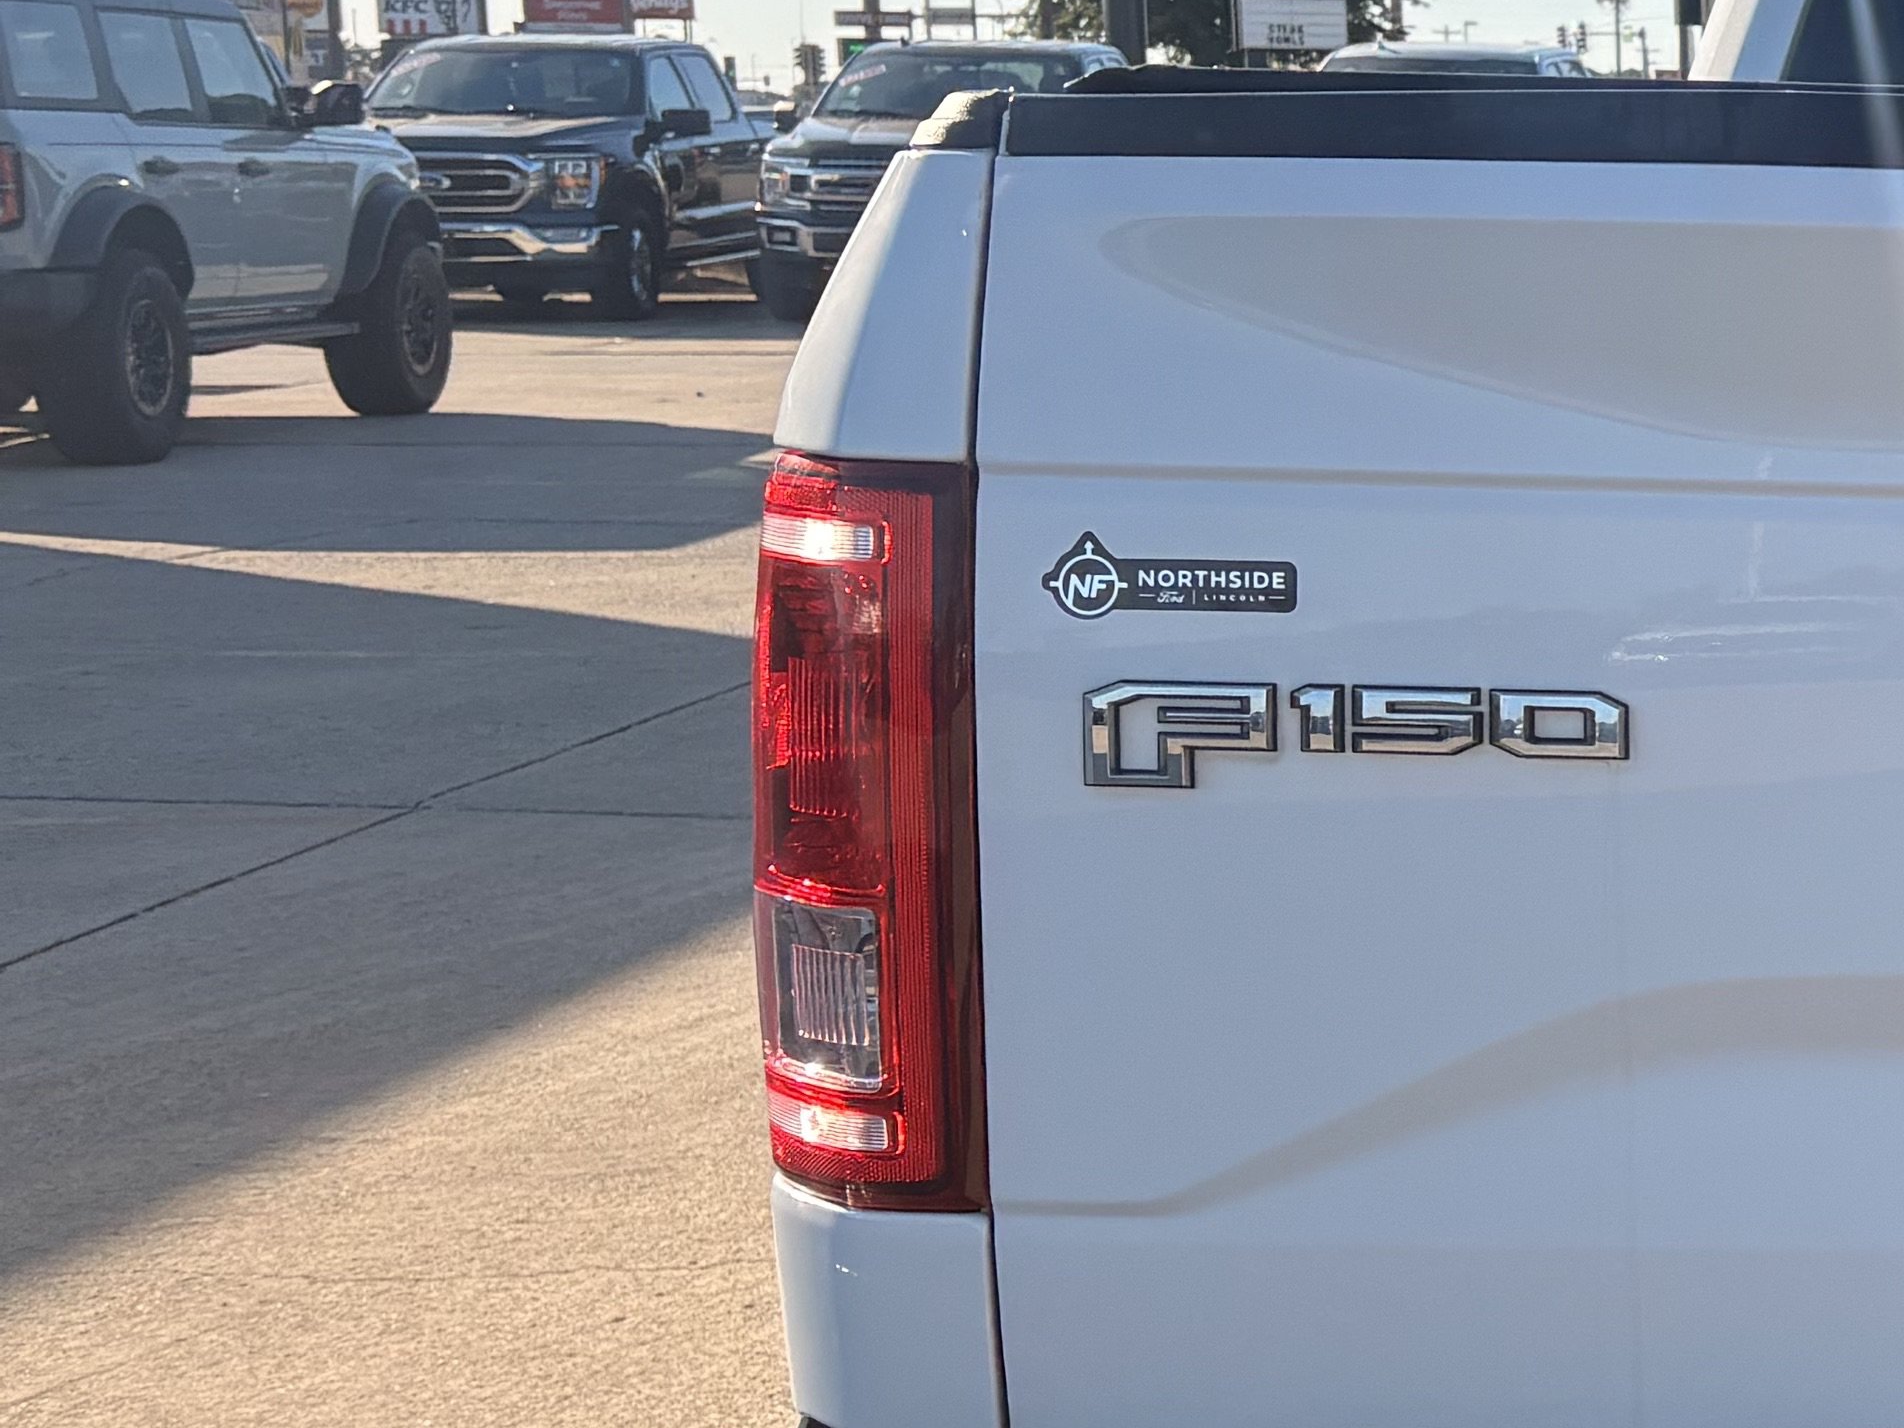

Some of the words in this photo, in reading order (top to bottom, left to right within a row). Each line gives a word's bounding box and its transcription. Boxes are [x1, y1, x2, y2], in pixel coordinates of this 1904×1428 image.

[1137, 569, 1287, 590] NORTHSIDE
[1156, 590, 1186, 605] Ford
[1203, 593, 1267, 603] LINCOLN
